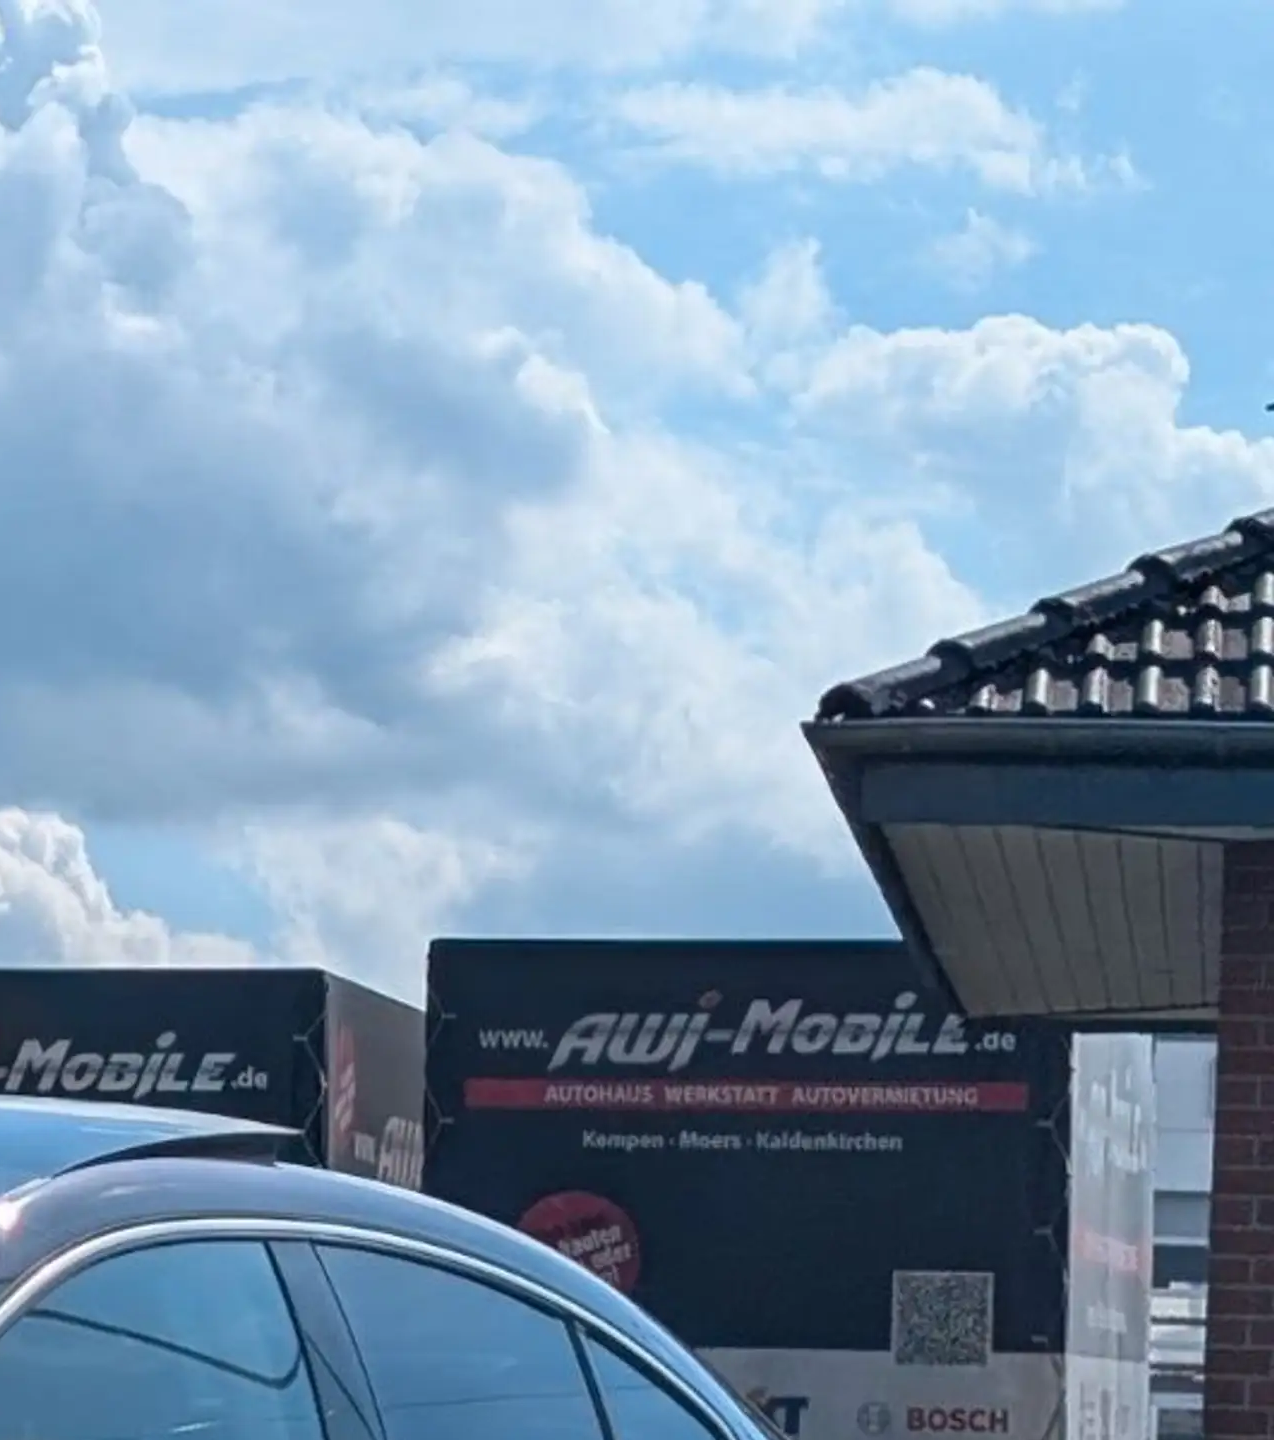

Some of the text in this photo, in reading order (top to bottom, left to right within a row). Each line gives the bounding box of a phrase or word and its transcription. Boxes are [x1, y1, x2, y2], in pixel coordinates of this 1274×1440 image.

[544, 1083, 979, 1107] AUTOHAUS WERKSTATT AUTOVERMIETUNG
[582, 1130, 903, 1151] Kempen Moers Kaldenkirchen
[905, 1406, 1009, 1434] BOSCH
